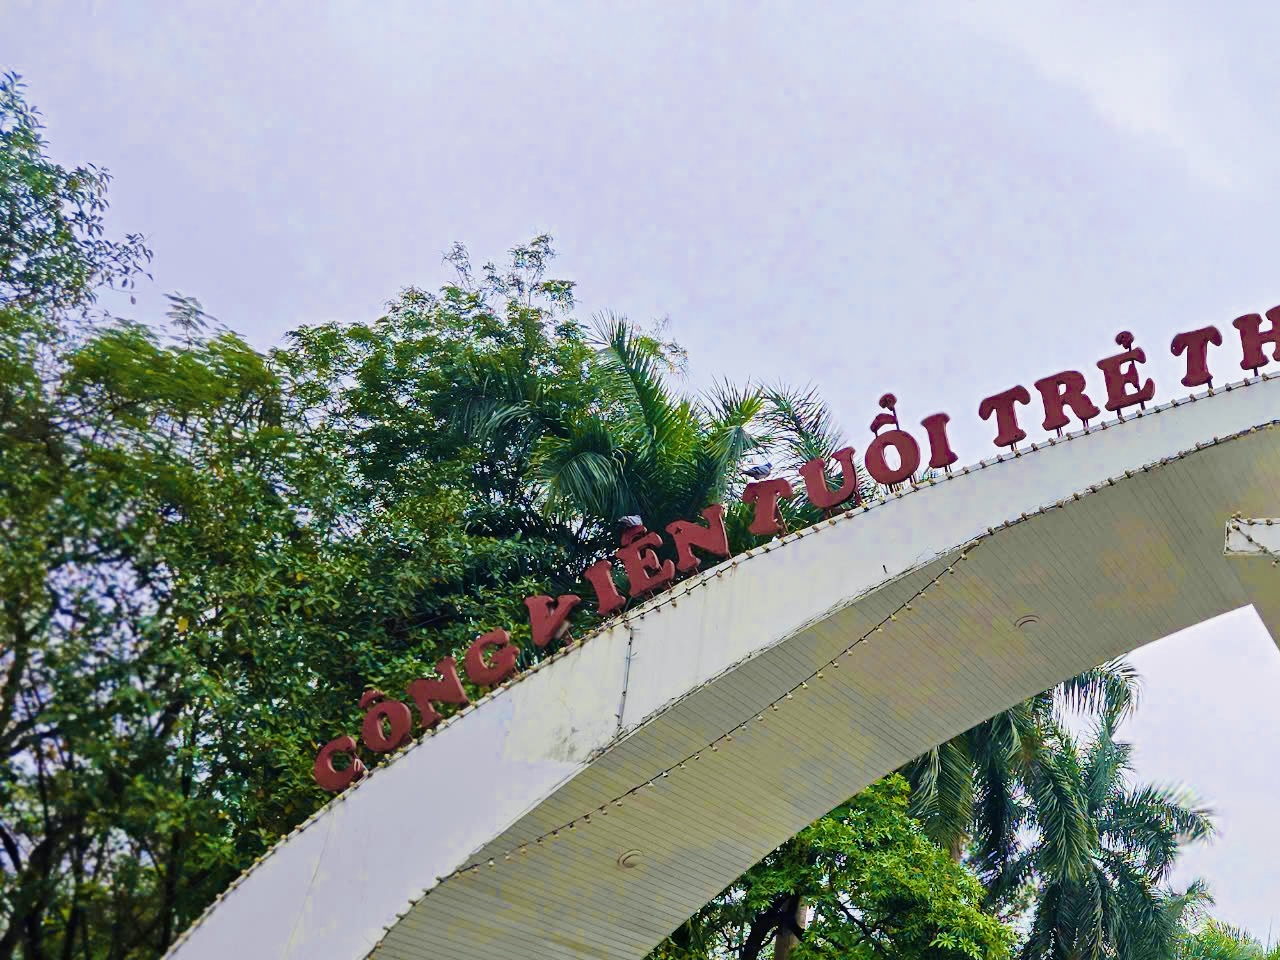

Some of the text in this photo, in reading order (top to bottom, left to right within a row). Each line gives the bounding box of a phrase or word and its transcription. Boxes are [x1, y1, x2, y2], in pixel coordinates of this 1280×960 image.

[314, 628, 520, 792] CÔNG
[523, 504, 730, 648] VIÊN
[742, 393, 958, 537] TUỔI
[978, 330, 1154, 448] TRẺ
